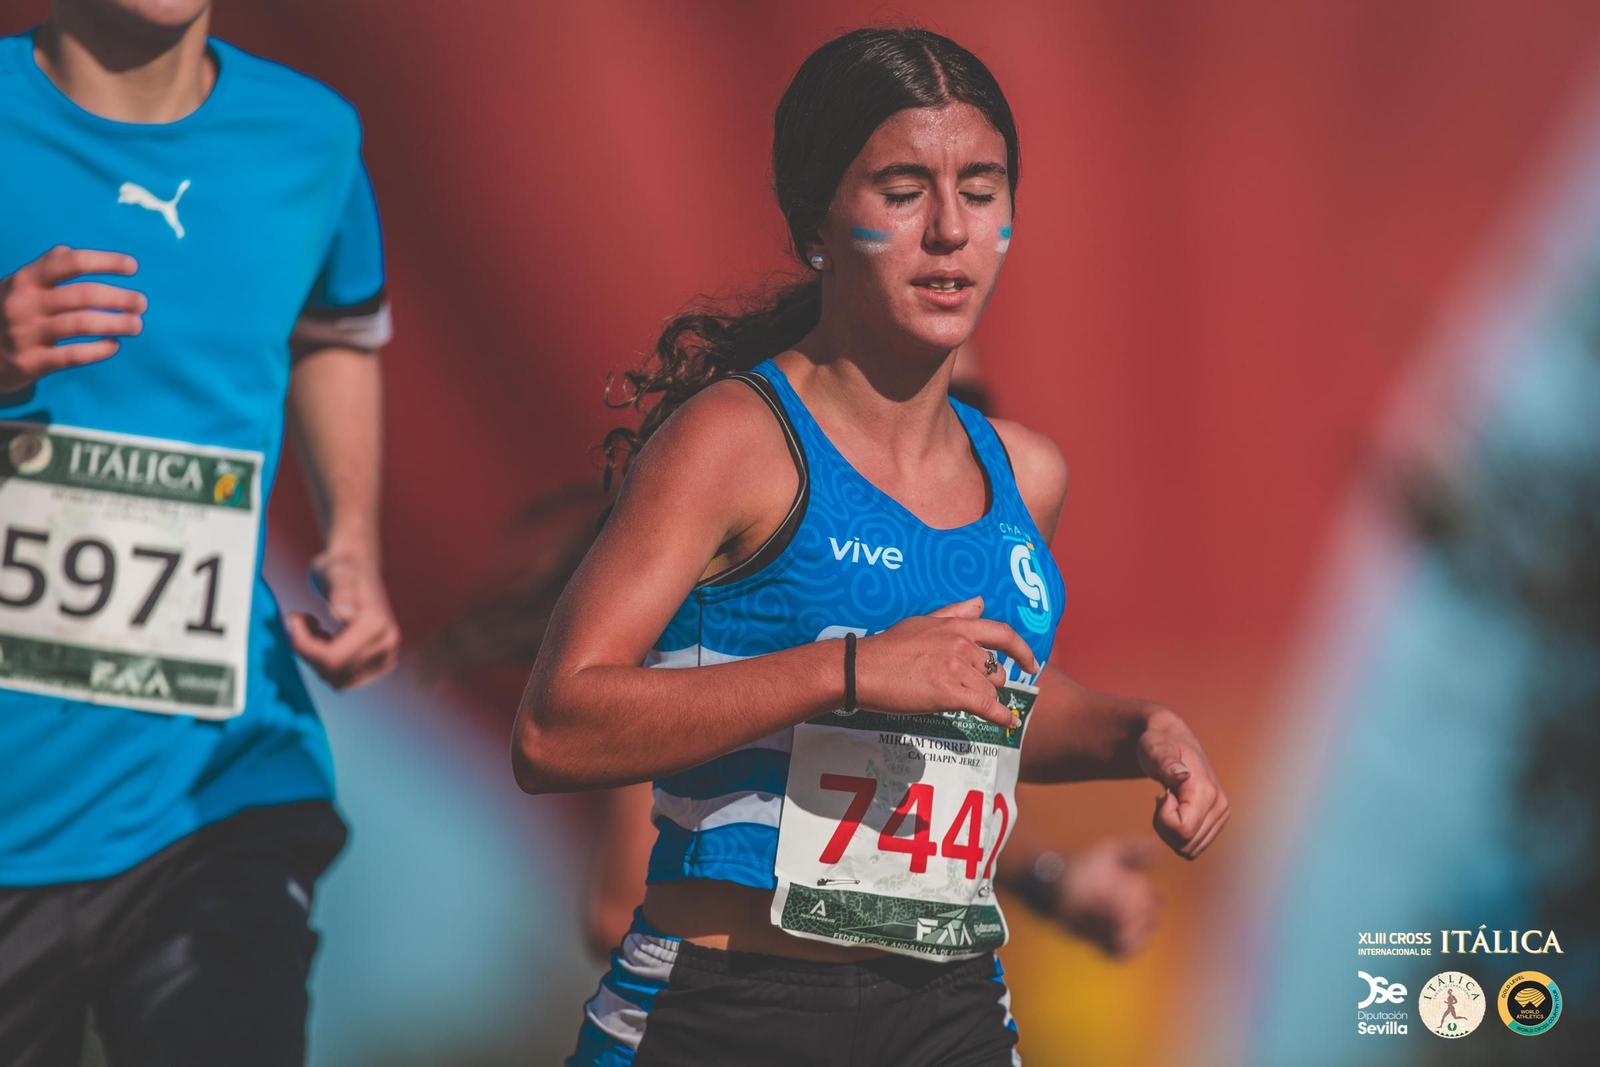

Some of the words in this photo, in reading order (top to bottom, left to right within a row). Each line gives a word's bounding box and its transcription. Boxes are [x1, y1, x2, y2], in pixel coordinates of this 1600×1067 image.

[69, 440, 204, 491] ITÁLICA
[828, 536, 904, 570] vive
[0, 525, 228, 637] 5971
[952, 720, 976, 730] CROSS
[878, 733, 925, 750] MIRIAM
[983, 745, 998, 758] RIO
[908, 751, 921, 761] CA
[923, 752, 958, 766] CHAPIN
[958, 755, 981, 768] JEREZ
[818, 773, 1008, 880] 7442
